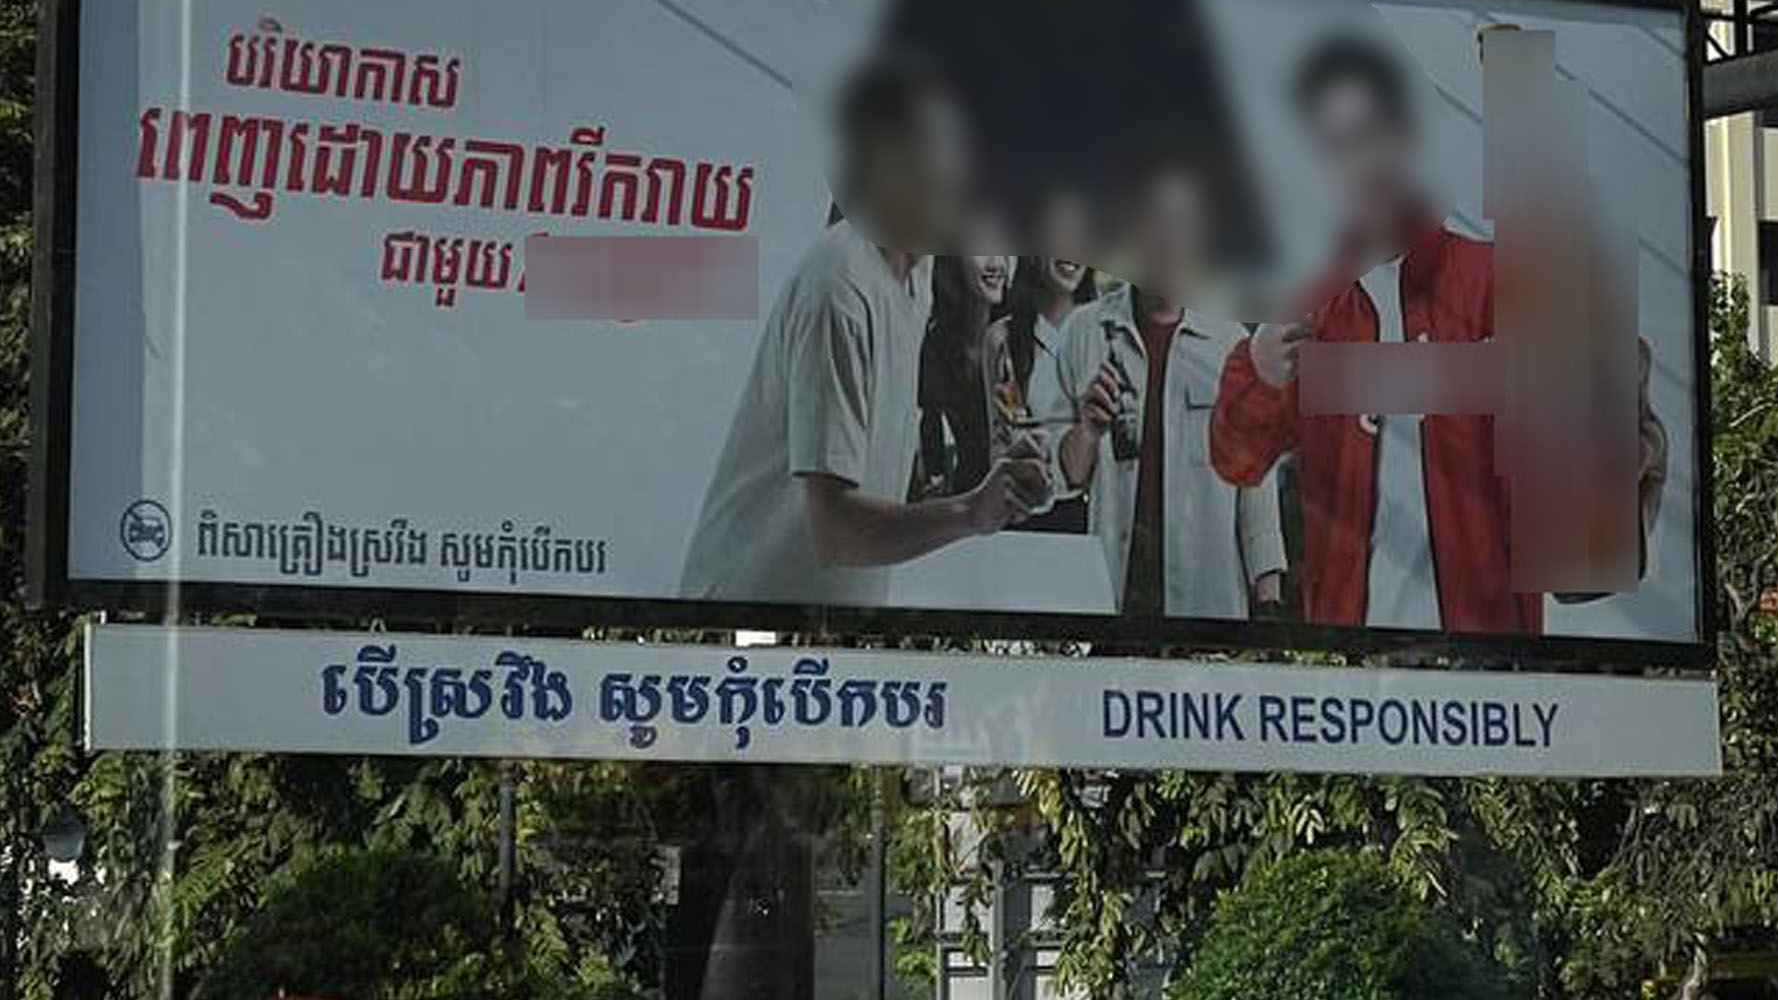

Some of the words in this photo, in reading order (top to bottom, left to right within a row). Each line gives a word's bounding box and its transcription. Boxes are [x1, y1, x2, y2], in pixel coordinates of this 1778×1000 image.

[225, 17, 461, 109] បរិយាកាស
[134, 107, 754, 232] ពេញដោយភាពរីករាយ
[440, 521, 607, 584] សូមកុំបើកបរ
[322, 644, 574, 745] បើស្រវឹង
[600, 655, 948, 749] សូមកុំបើកបរ
[1101, 689, 1246, 742] DRINK
[1259, 695, 1558, 748] RESPONSIBLY
